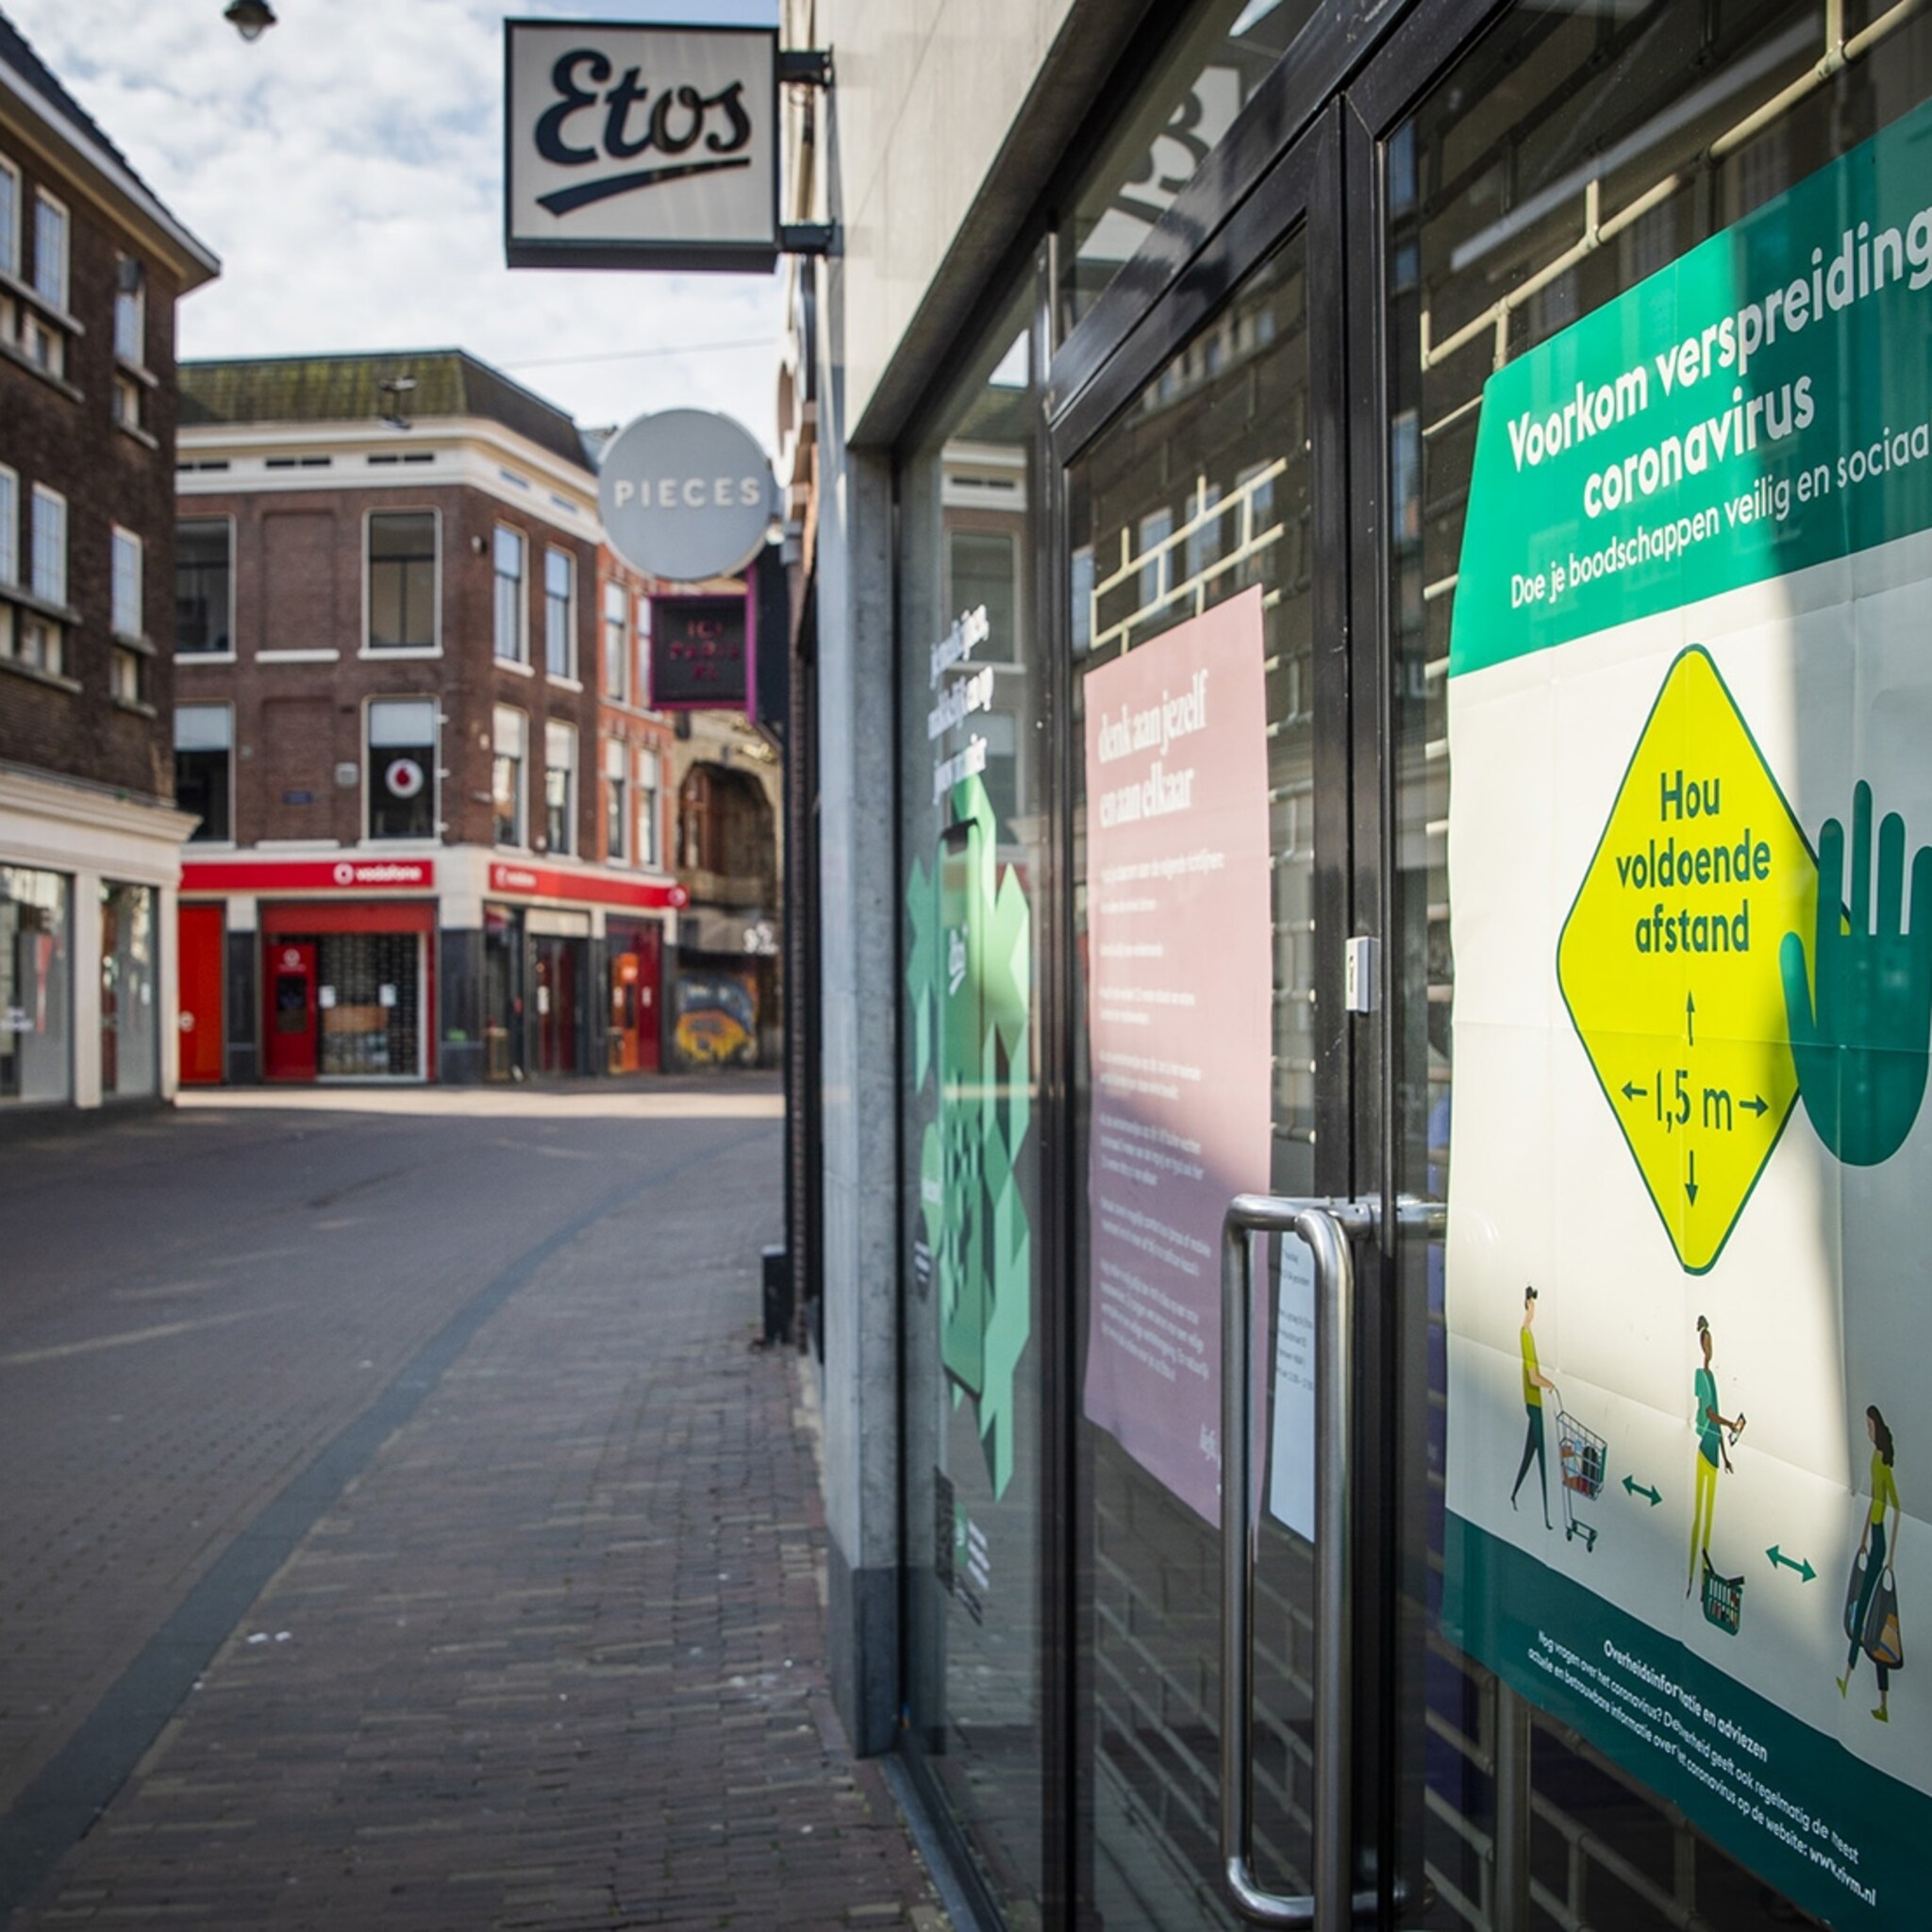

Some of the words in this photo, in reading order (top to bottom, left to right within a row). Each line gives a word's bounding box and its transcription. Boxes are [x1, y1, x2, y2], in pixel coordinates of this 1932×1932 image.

[534, 48, 752, 167] Etos
[1507, 365, 1647, 472] Voorkom
[1656, 205, 1932, 396] verspreiding
[1584, 375, 1815, 518] coronavirus
[615, 476, 760, 508] PIECES
[1511, 570, 1545, 608] Doe
[1549, 562, 1565, 602] je
[1569, 508, 1719, 583] boodschappen
[1724, 475, 1790, 528] veilig
[1797, 465, 1830, 502] en
[1837, 424, 1929, 488] sociaa
[1660, 770, 1721, 822] Hou
[1616, 828, 1772, 890] voldoende
[1635, 899, 1750, 953] afstand
[1655, 1070, 1691, 1133] 1,5
[1703, 1084, 1732, 1131] m
[1703, 1707, 1717, 1728] en
[1718, 1718, 1768, 1763] adviezen
[1653, 1734, 1675, 1756] over
[1737, 1796, 1751, 1817] op
[1751, 1805, 1765, 1825] de
[1766, 1816, 1808, 1857] website:
[1711, 1750, 1735, 1775] geeft
[1736, 1767, 1754, 1790] ook
[1755, 1781, 1810, 1832] regelmatig
[1811, 1817, 1830, 1839] de
